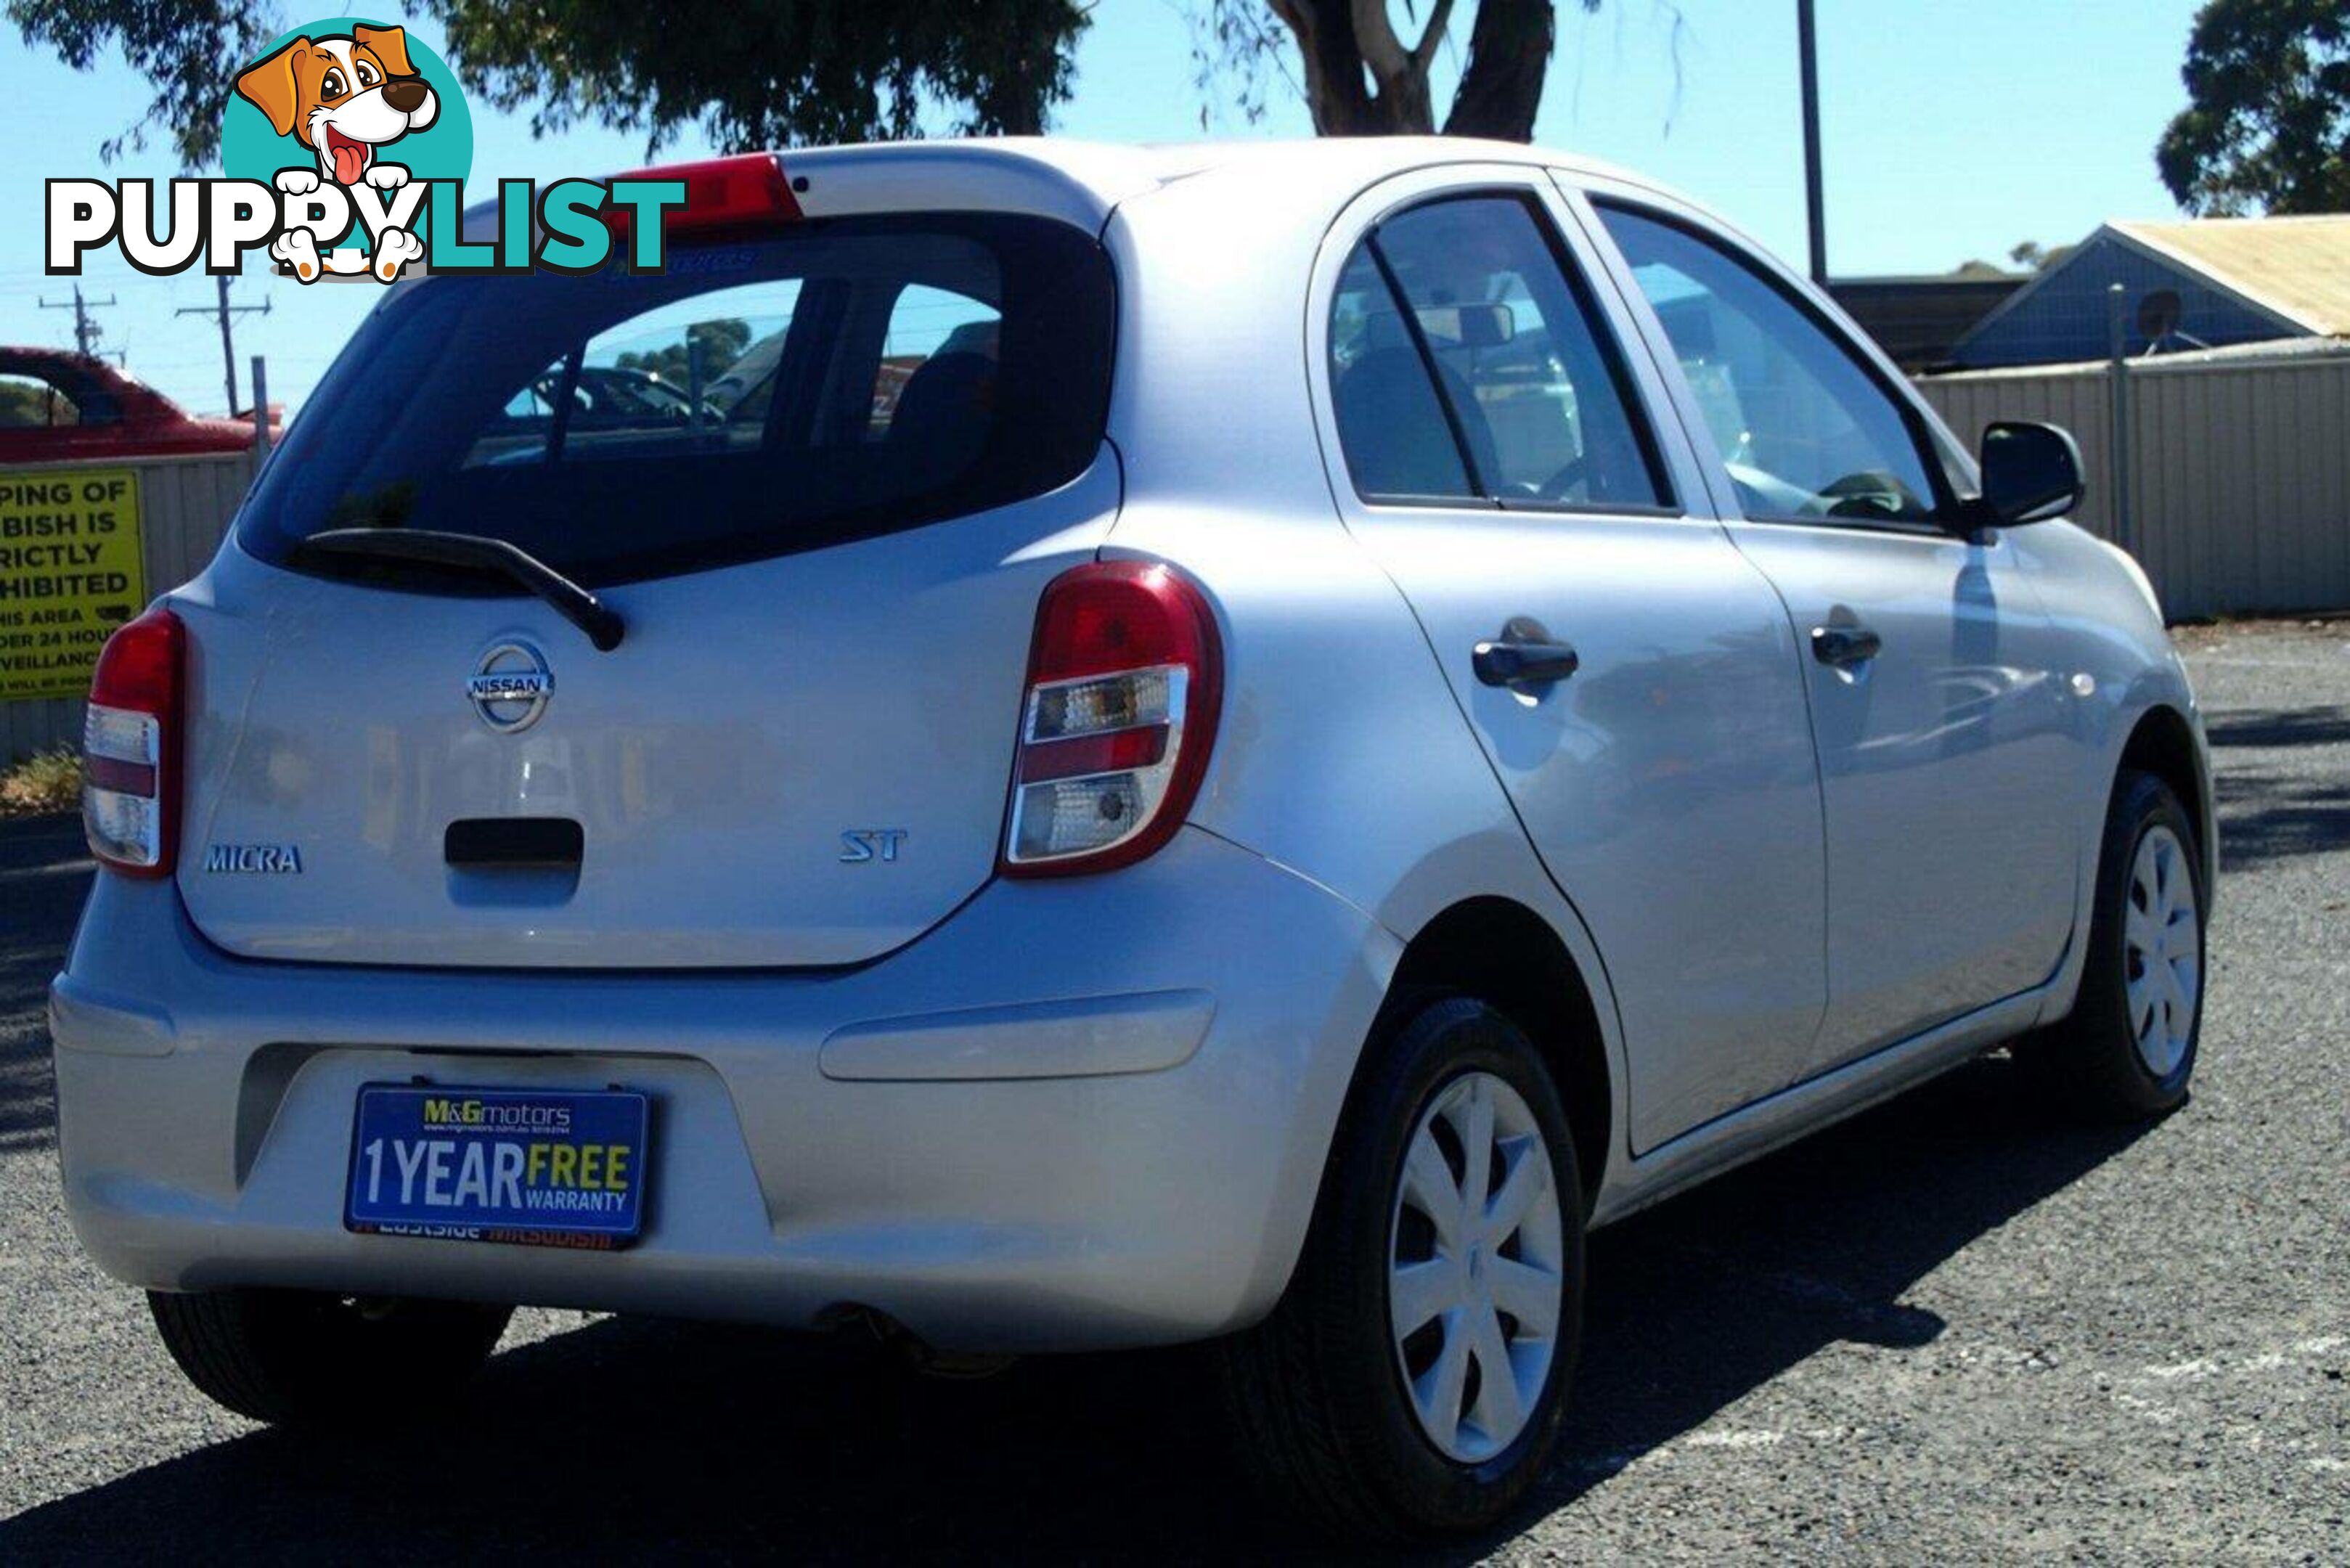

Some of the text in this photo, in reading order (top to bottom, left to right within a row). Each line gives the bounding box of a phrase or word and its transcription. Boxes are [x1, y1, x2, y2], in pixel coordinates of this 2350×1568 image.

[0, 481, 126, 506] PING OF
[3, 512, 116, 537] BISH IS
[0, 544, 102, 568] RICTLY
[0, 573, 128, 600] HIBITED
[30, 608, 83, 624] AREA
[40, 630, 62, 647] 24
[0, 650, 99, 670] VEILLANC
[473, 677, 541, 693] NISSAN
[840, 829, 907, 862] ST
[204, 844, 302, 873] MICRA
[425, 1099, 570, 1126] M&Gmotors
[365, 1138, 632, 1209] 1 YEAR FREE
[526, 1190, 627, 1212] WARRANTY
